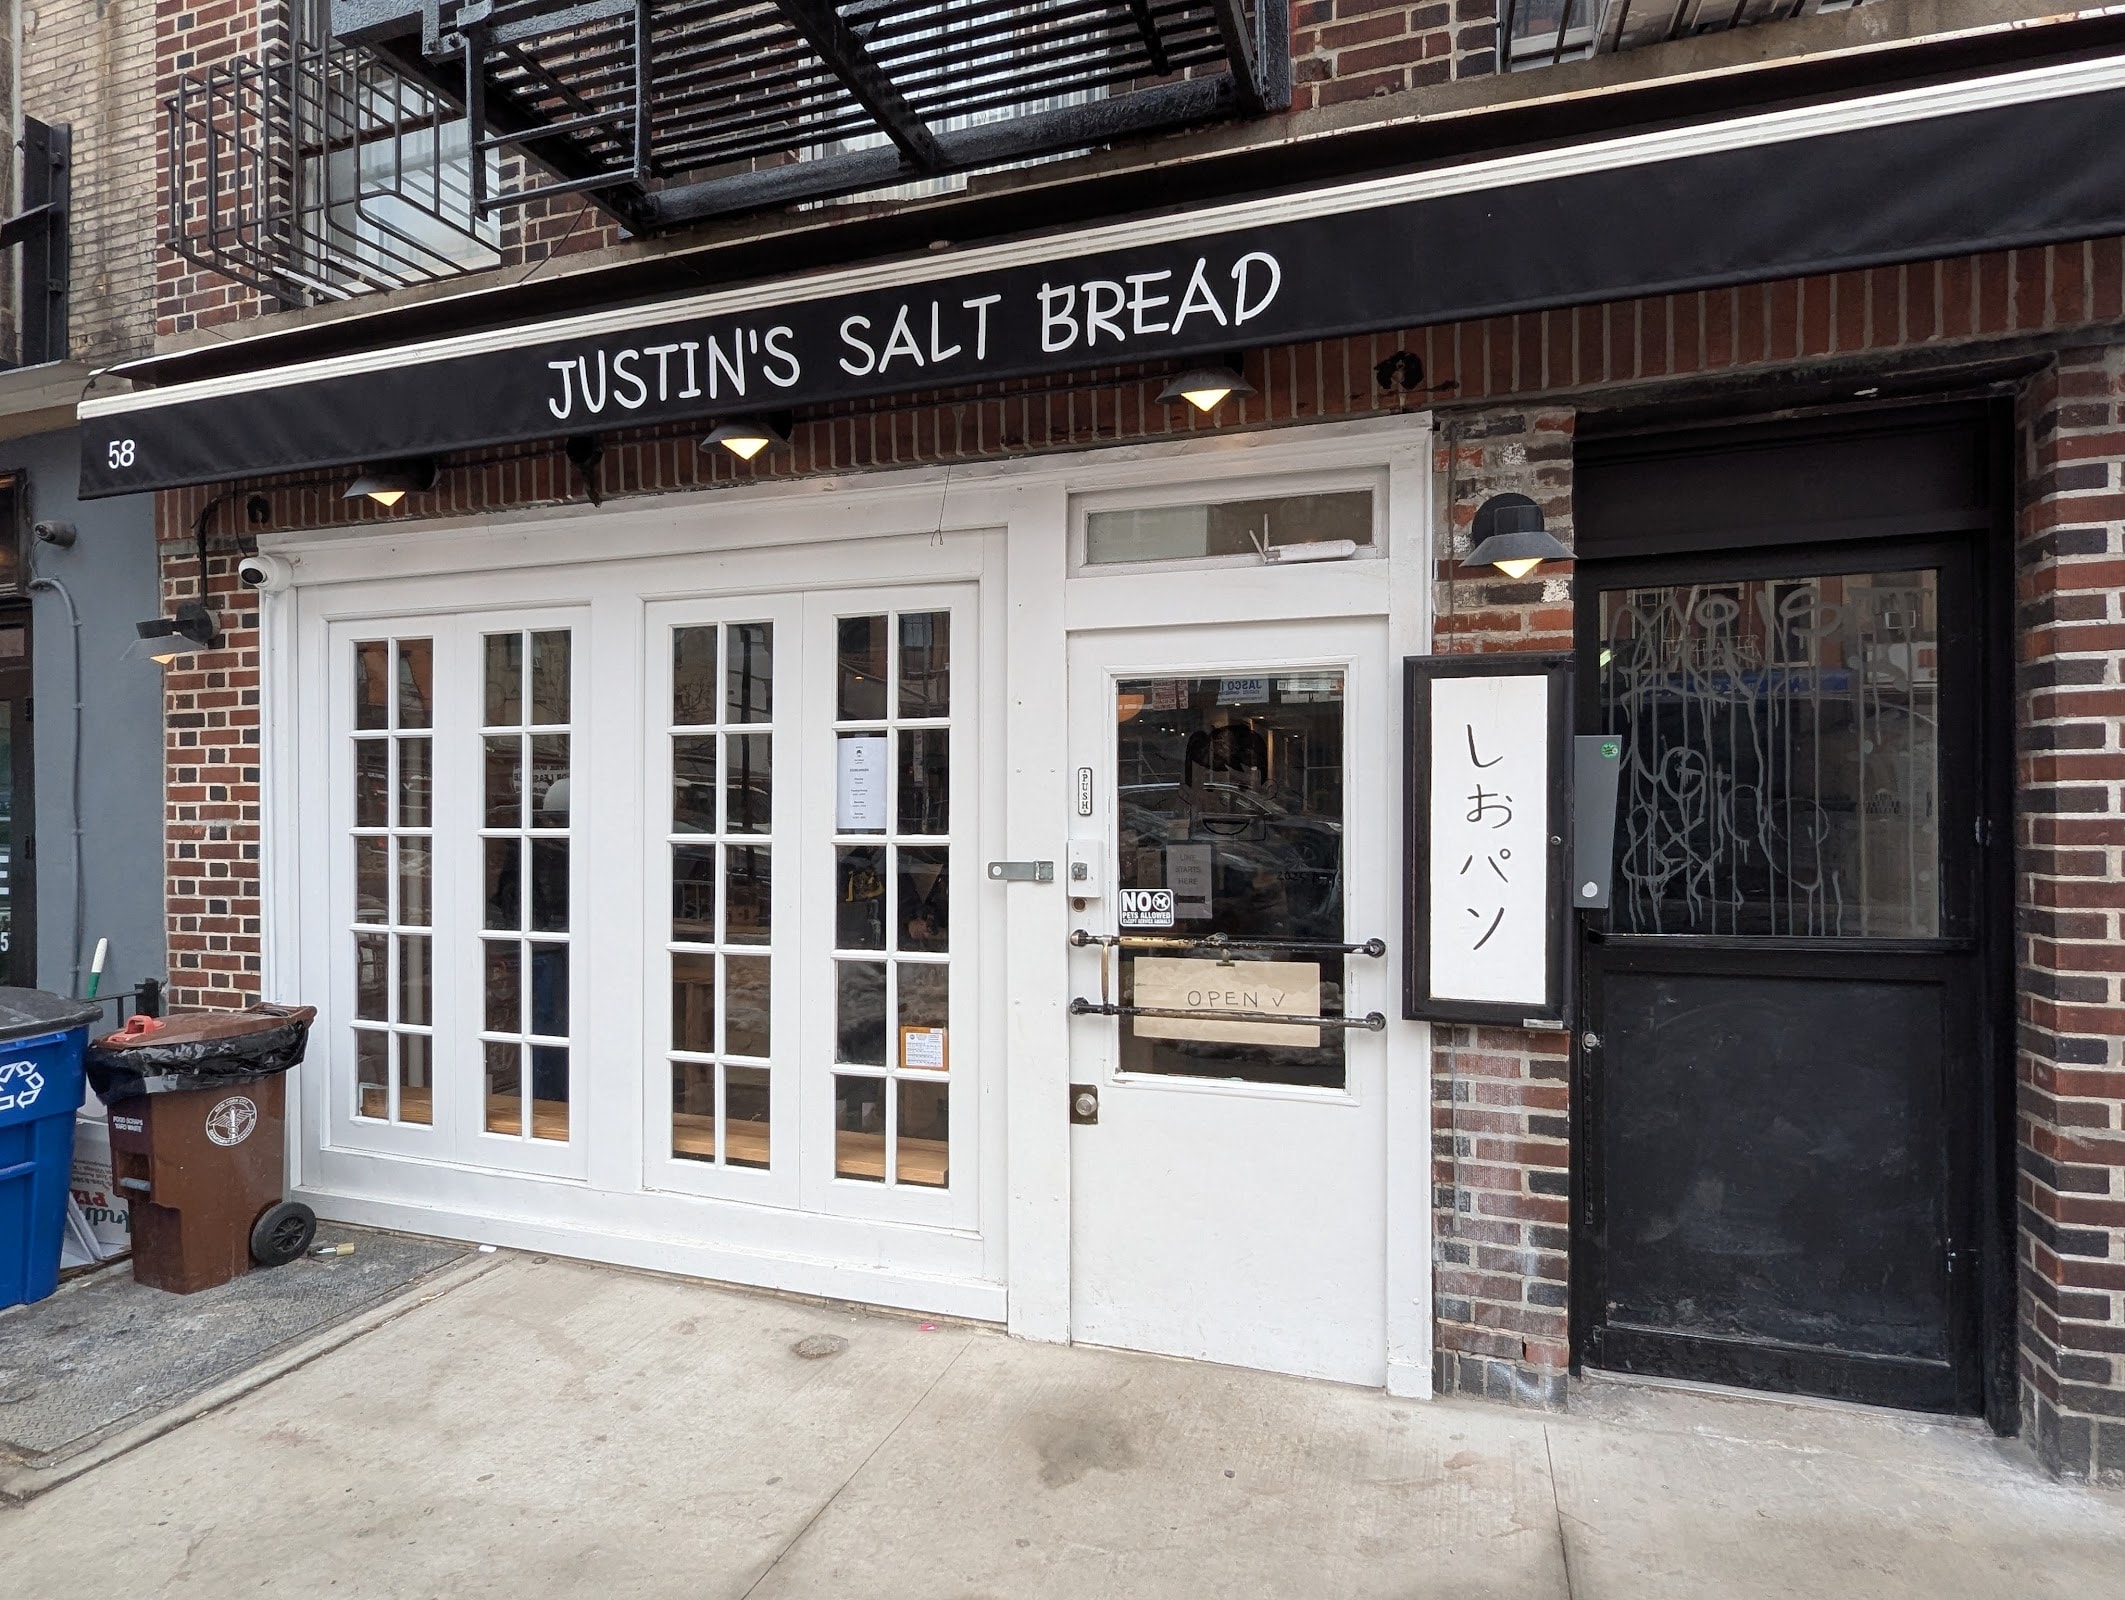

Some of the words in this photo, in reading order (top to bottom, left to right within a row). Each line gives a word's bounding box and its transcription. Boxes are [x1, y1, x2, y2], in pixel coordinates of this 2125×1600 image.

[549, 326, 801, 422] JUSTIN'S
[839, 294, 1002, 378] SALT
[1037, 251, 1282, 353] BREAD
[108, 439, 136, 469] 58
[1081, 773, 1089, 810] PUSH
[1175, 865, 1201, 873] STARTS
[1178, 877, 1198, 885] HERE
[1122, 891, 1152, 912] NO
[1122, 911, 1139, 919] PETS
[1140, 911, 1171, 919] ALLOWED
[1187, 990, 1258, 1008] OPEN
